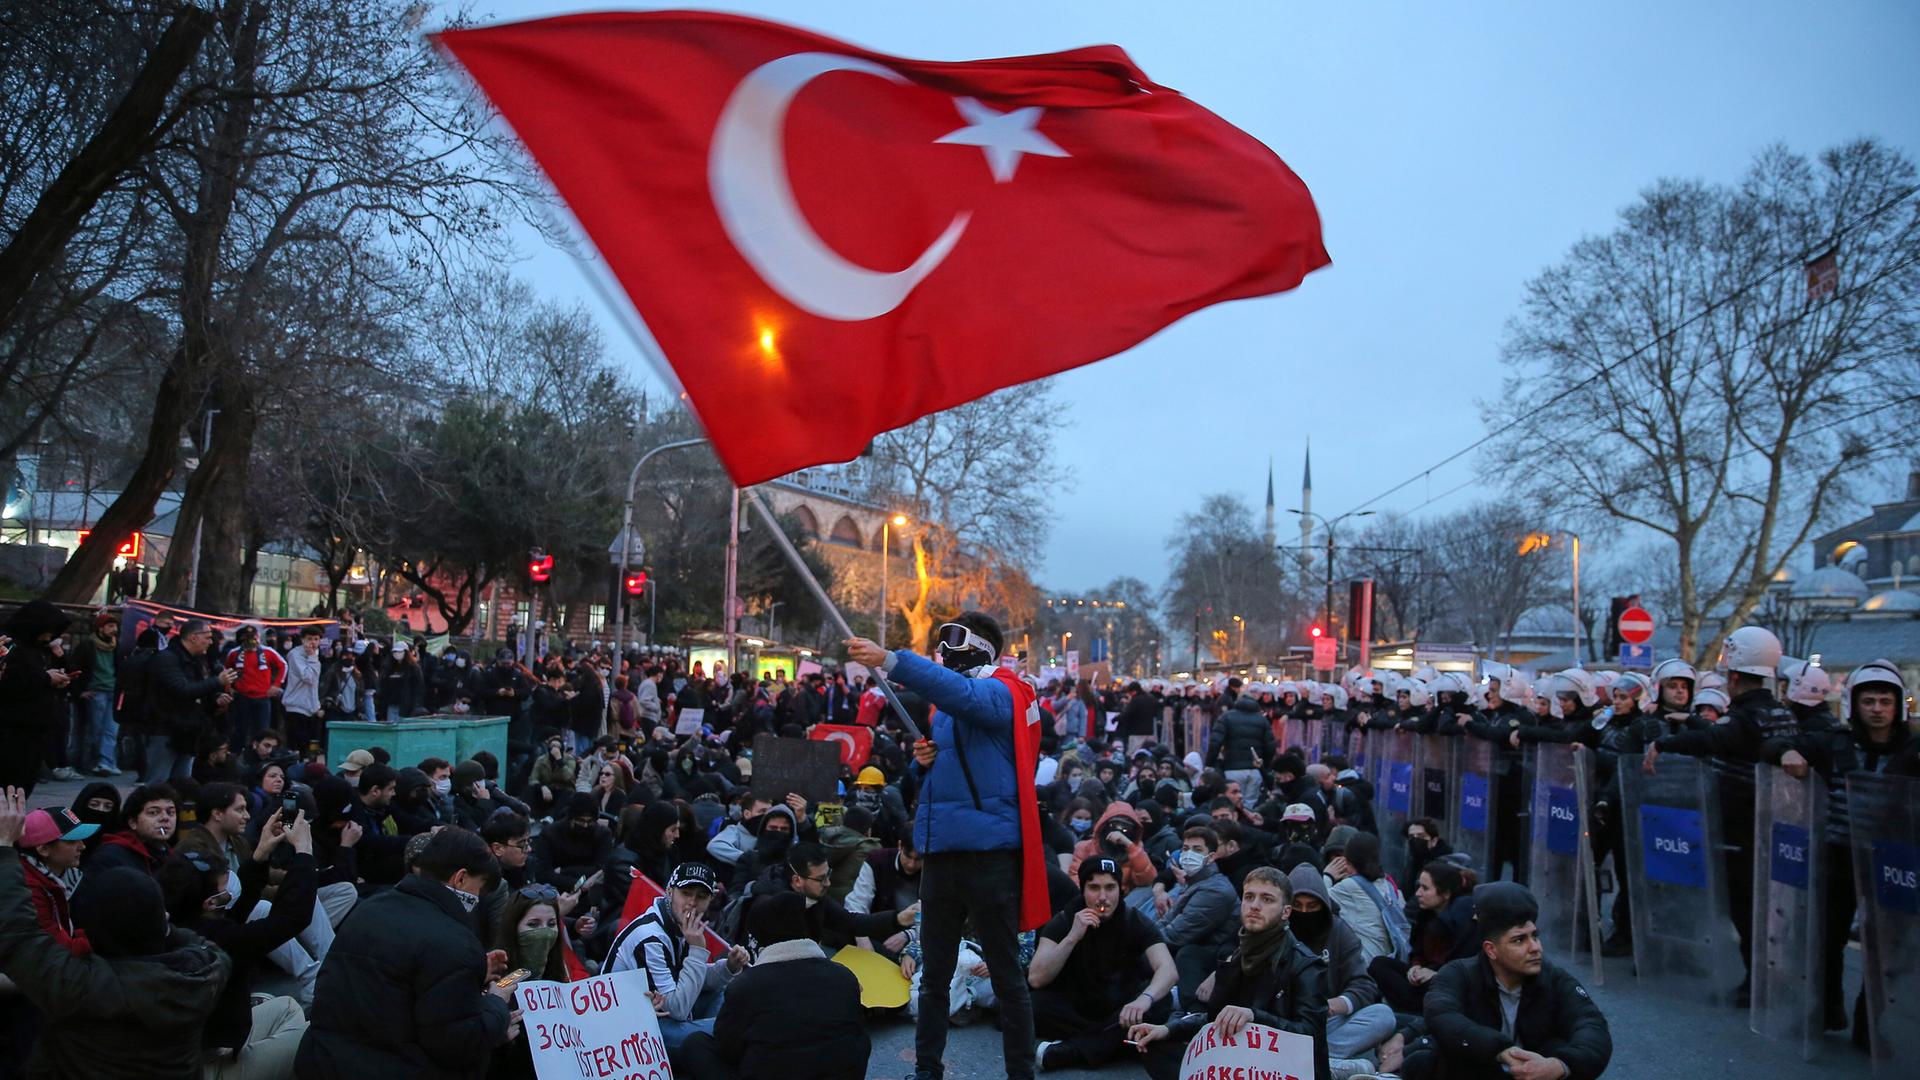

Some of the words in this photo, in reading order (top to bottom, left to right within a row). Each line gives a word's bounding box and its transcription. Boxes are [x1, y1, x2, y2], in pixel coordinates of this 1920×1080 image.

[1655, 837, 1690, 855] POLİS
[571, 977, 619, 1015] GİBİ
[536, 1024, 552, 1050] 3
